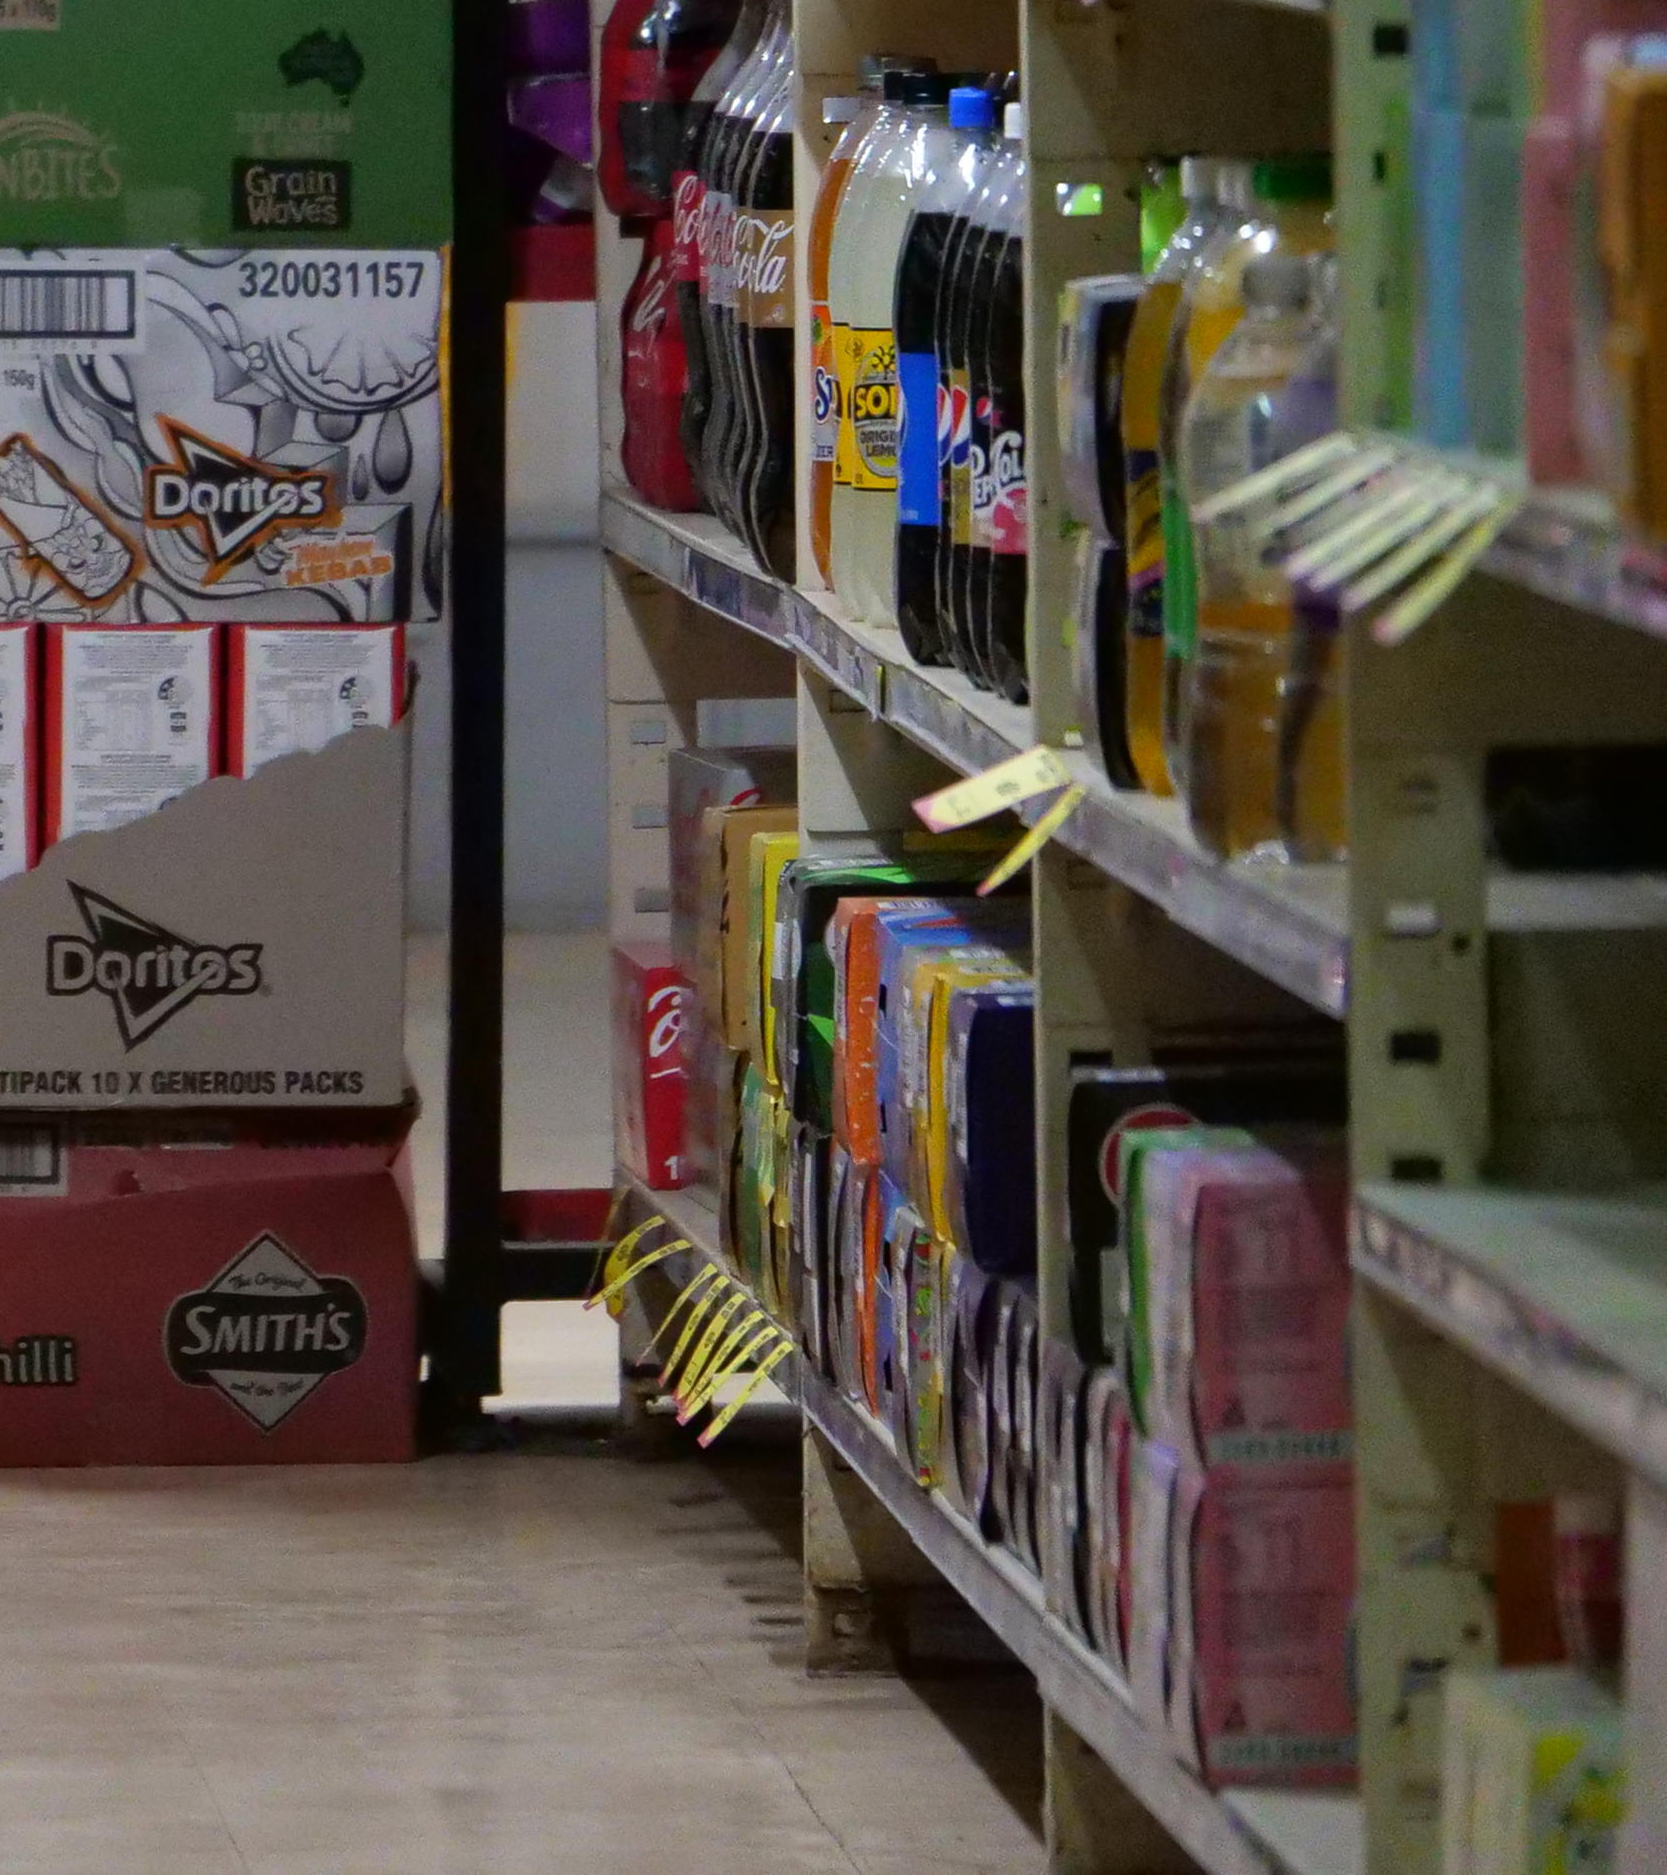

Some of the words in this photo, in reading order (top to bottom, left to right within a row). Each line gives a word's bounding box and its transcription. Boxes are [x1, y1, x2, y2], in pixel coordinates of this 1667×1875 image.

[243, 164, 338, 197] Grain
[246, 195, 340, 226] Waves
[238, 260, 426, 299] 320031157
[154, 471, 326, 518] Doritos
[285, 555, 392, 587] KEBAB
[51, 942, 264, 994] Doritos
[91, 1070, 120, 1095] 10
[128, 1070, 143, 1096] X
[150, 1069, 275, 1096] GENEROUS
[284, 1070, 365, 1096] PACKS
[179, 1301, 353, 1356] SMITH'S
